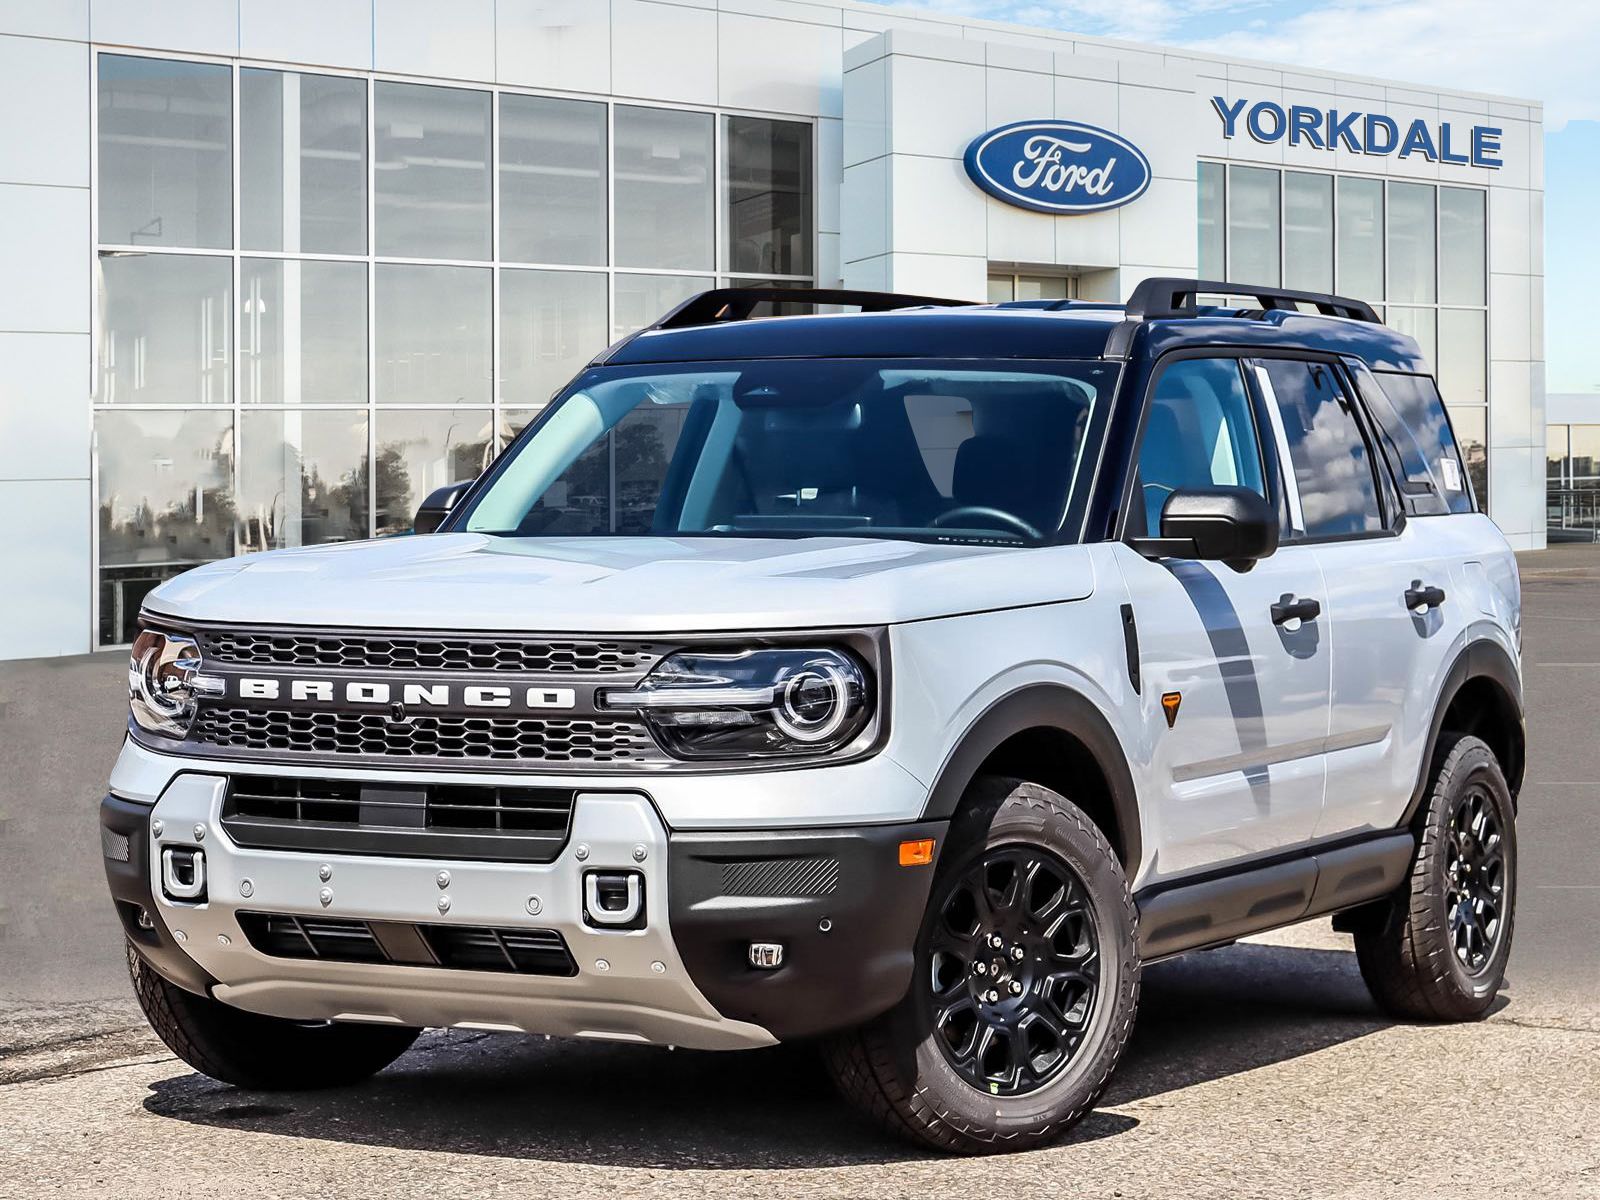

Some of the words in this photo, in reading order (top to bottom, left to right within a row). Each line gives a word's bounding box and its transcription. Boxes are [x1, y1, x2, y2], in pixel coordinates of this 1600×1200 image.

[1210, 95, 1503, 169] YORKDALE
[1012, 135, 1117, 196] Ford
[239, 678, 576, 708] BRONCO
